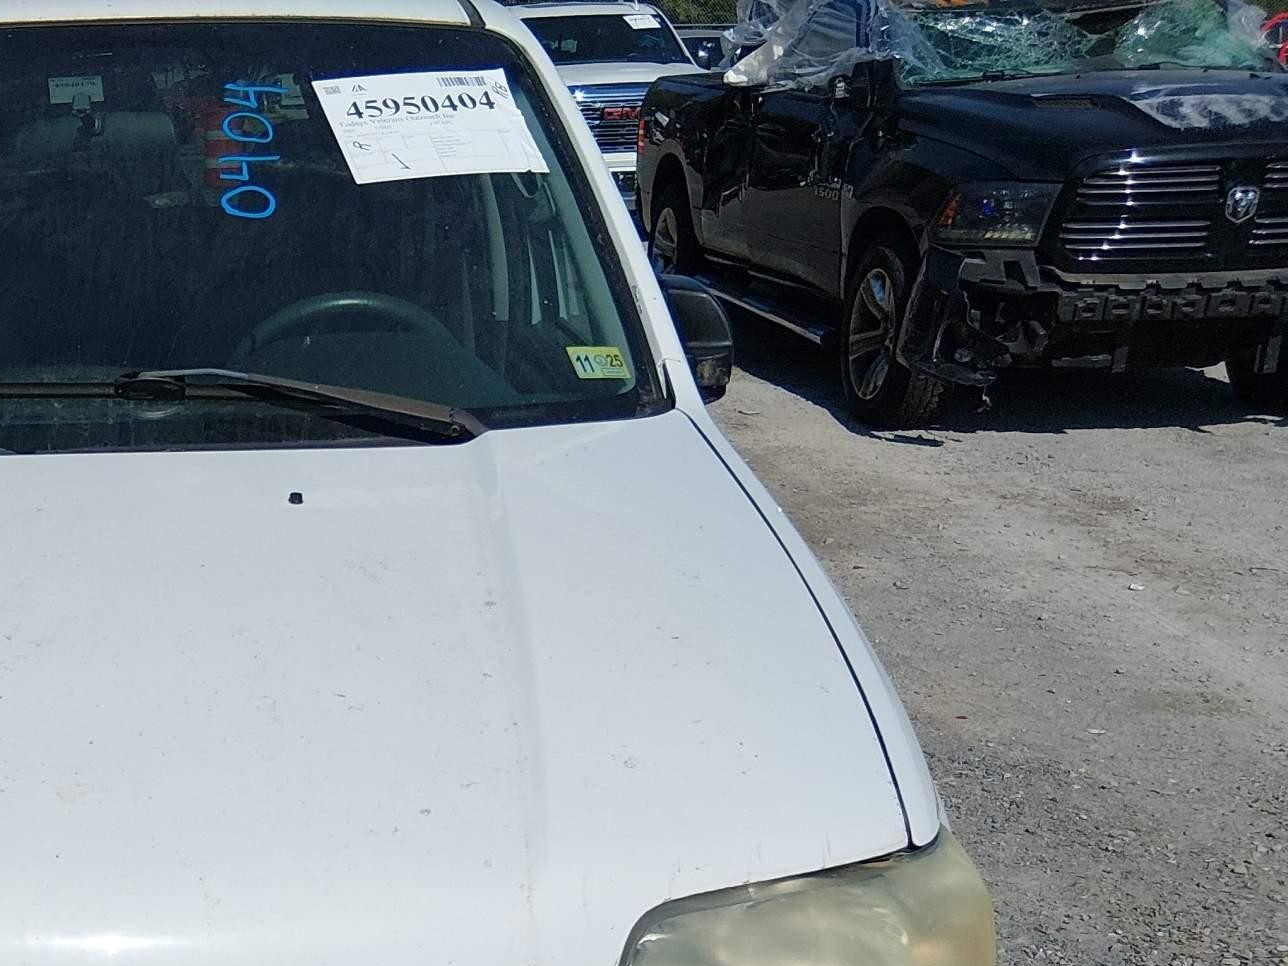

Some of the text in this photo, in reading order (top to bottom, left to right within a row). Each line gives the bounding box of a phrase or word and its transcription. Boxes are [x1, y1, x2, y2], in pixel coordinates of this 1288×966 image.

[347, 91, 496, 119] 45950404
[221, 82, 289, 219] 0404
[576, 355, 595, 373] 11
[606, 354, 624, 368] 25
